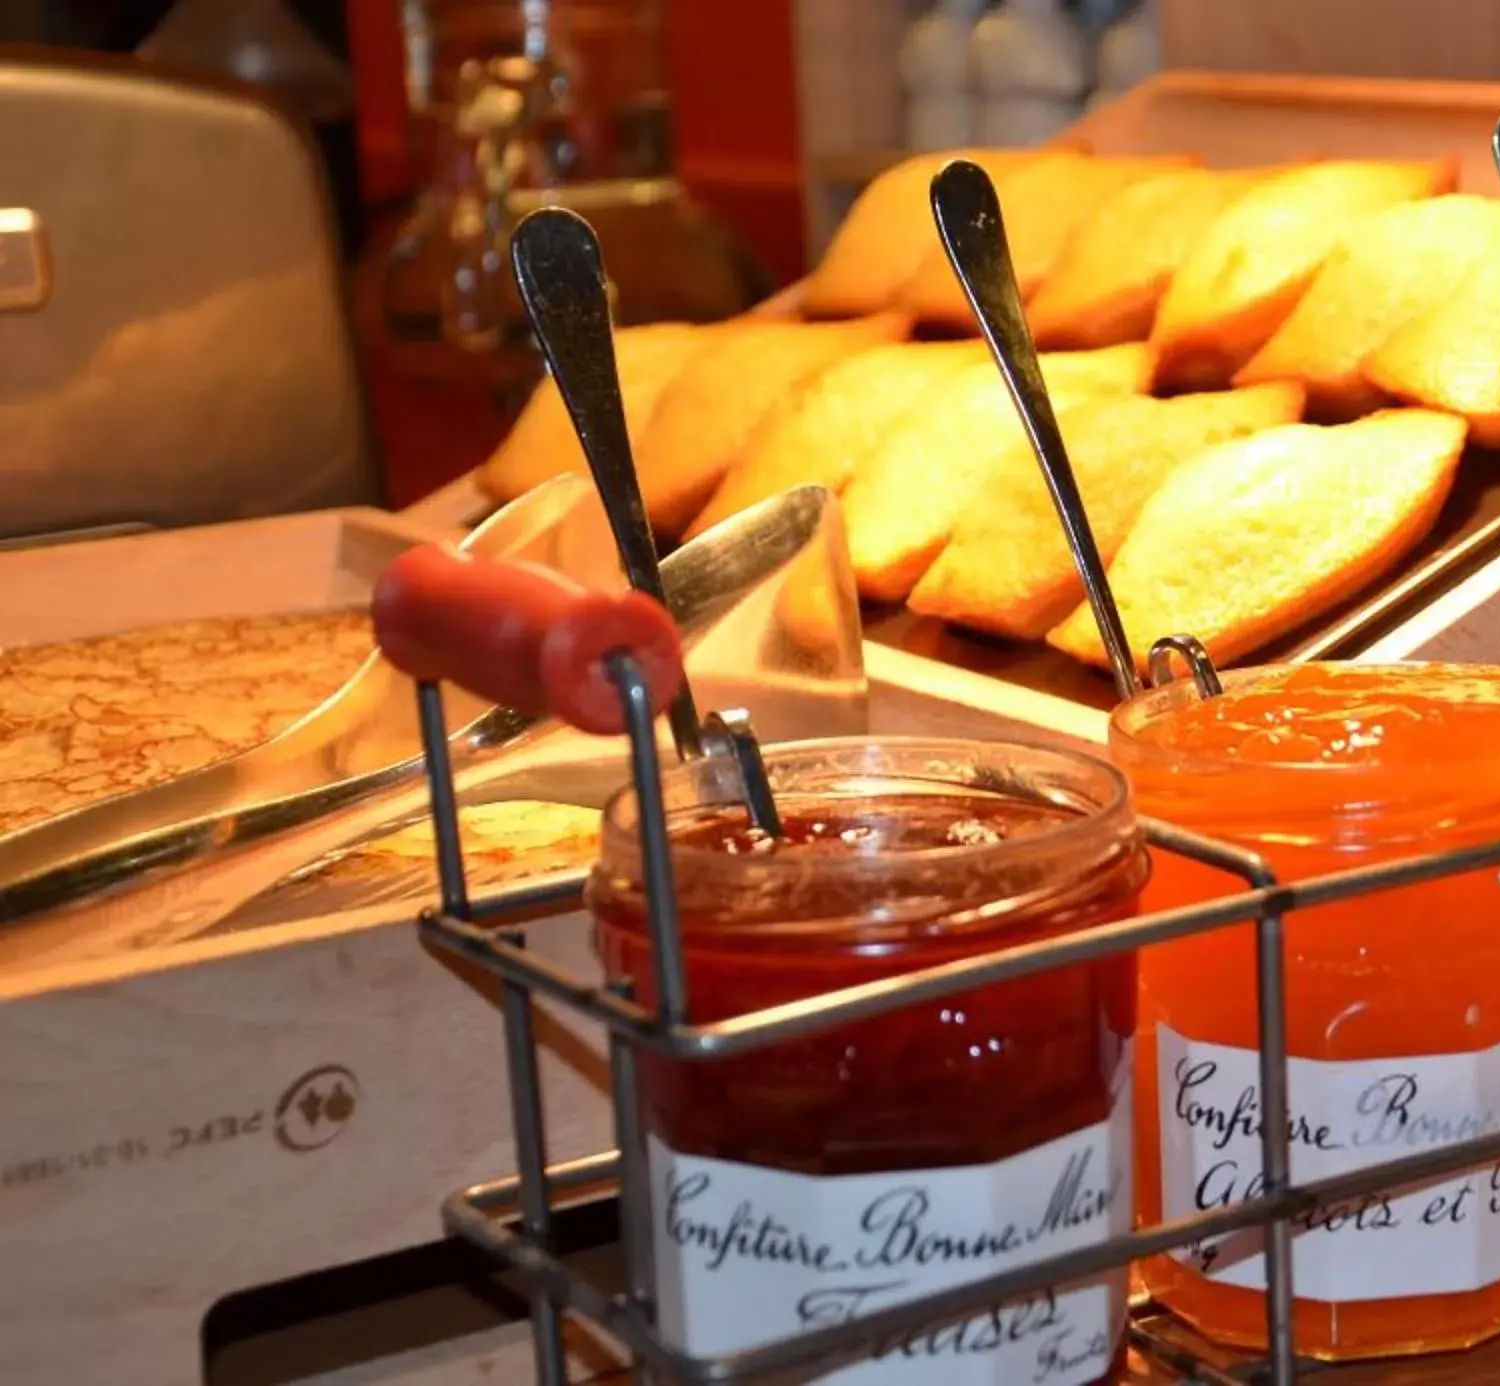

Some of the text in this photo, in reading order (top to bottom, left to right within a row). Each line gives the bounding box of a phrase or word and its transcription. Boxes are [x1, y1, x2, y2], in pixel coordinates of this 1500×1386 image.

[1175, 1056, 1345, 1149] Confire
[665, 1166, 849, 1273] Confiture
[854, 1185, 1023, 1269] Bonne
[1421, 1180, 1475, 1225] et
